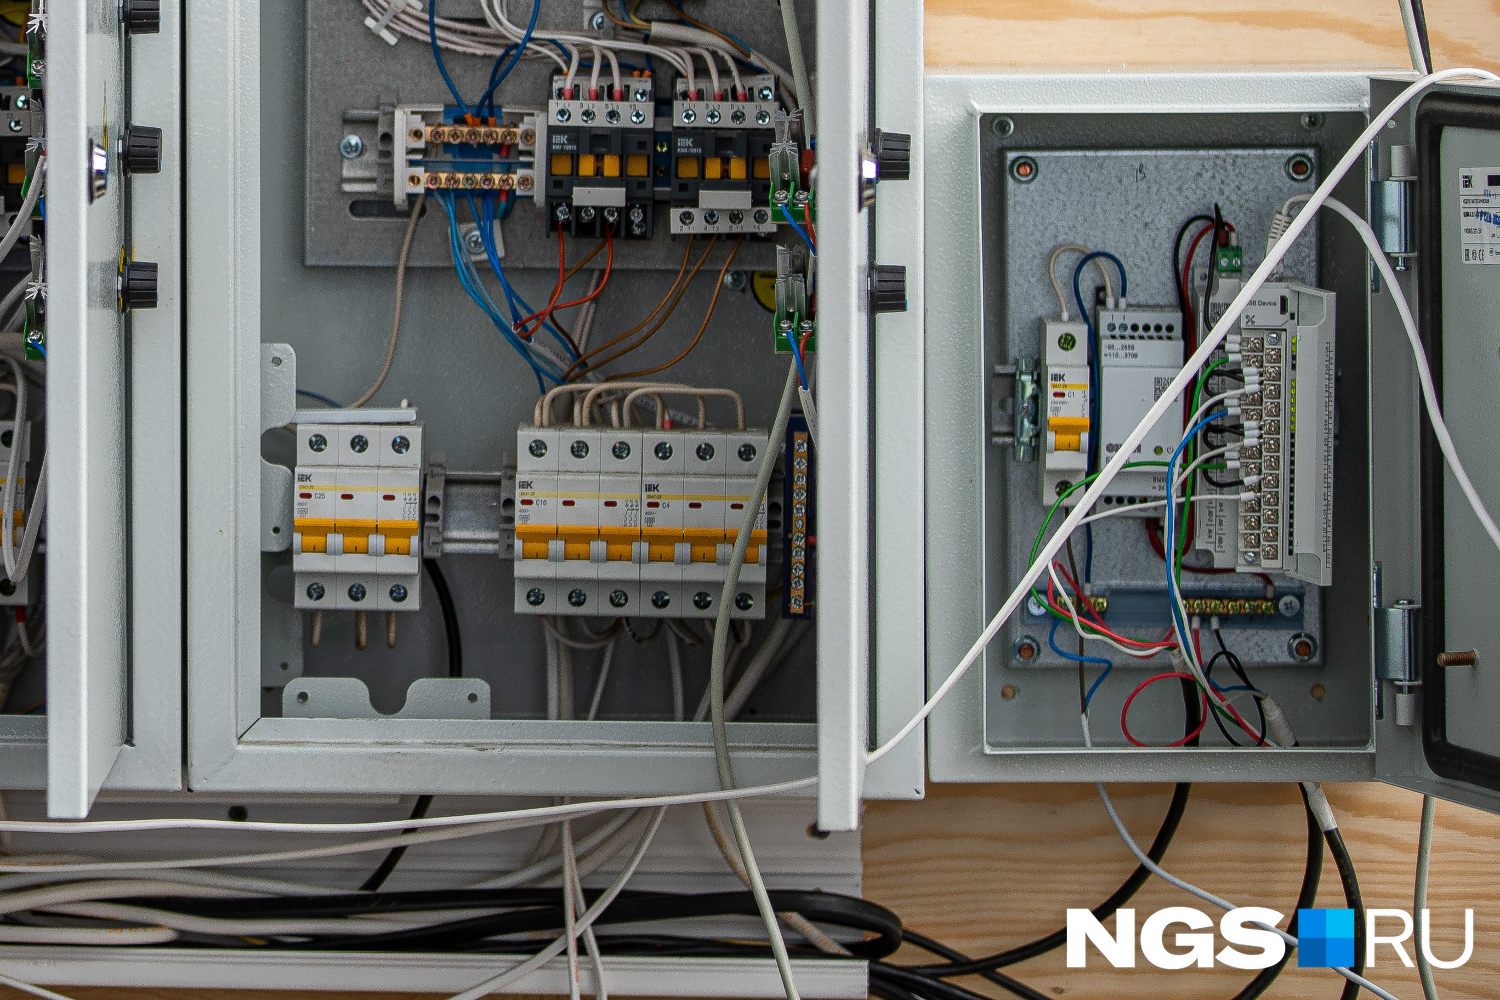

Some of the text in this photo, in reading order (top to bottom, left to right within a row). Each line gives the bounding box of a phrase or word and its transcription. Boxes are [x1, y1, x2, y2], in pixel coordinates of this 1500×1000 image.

[1051, 373, 1066, 382] IEK
[297, 474, 312, 482] IEK
[518, 481, 533, 489] IEK
[644, 484, 660, 492] IEK
